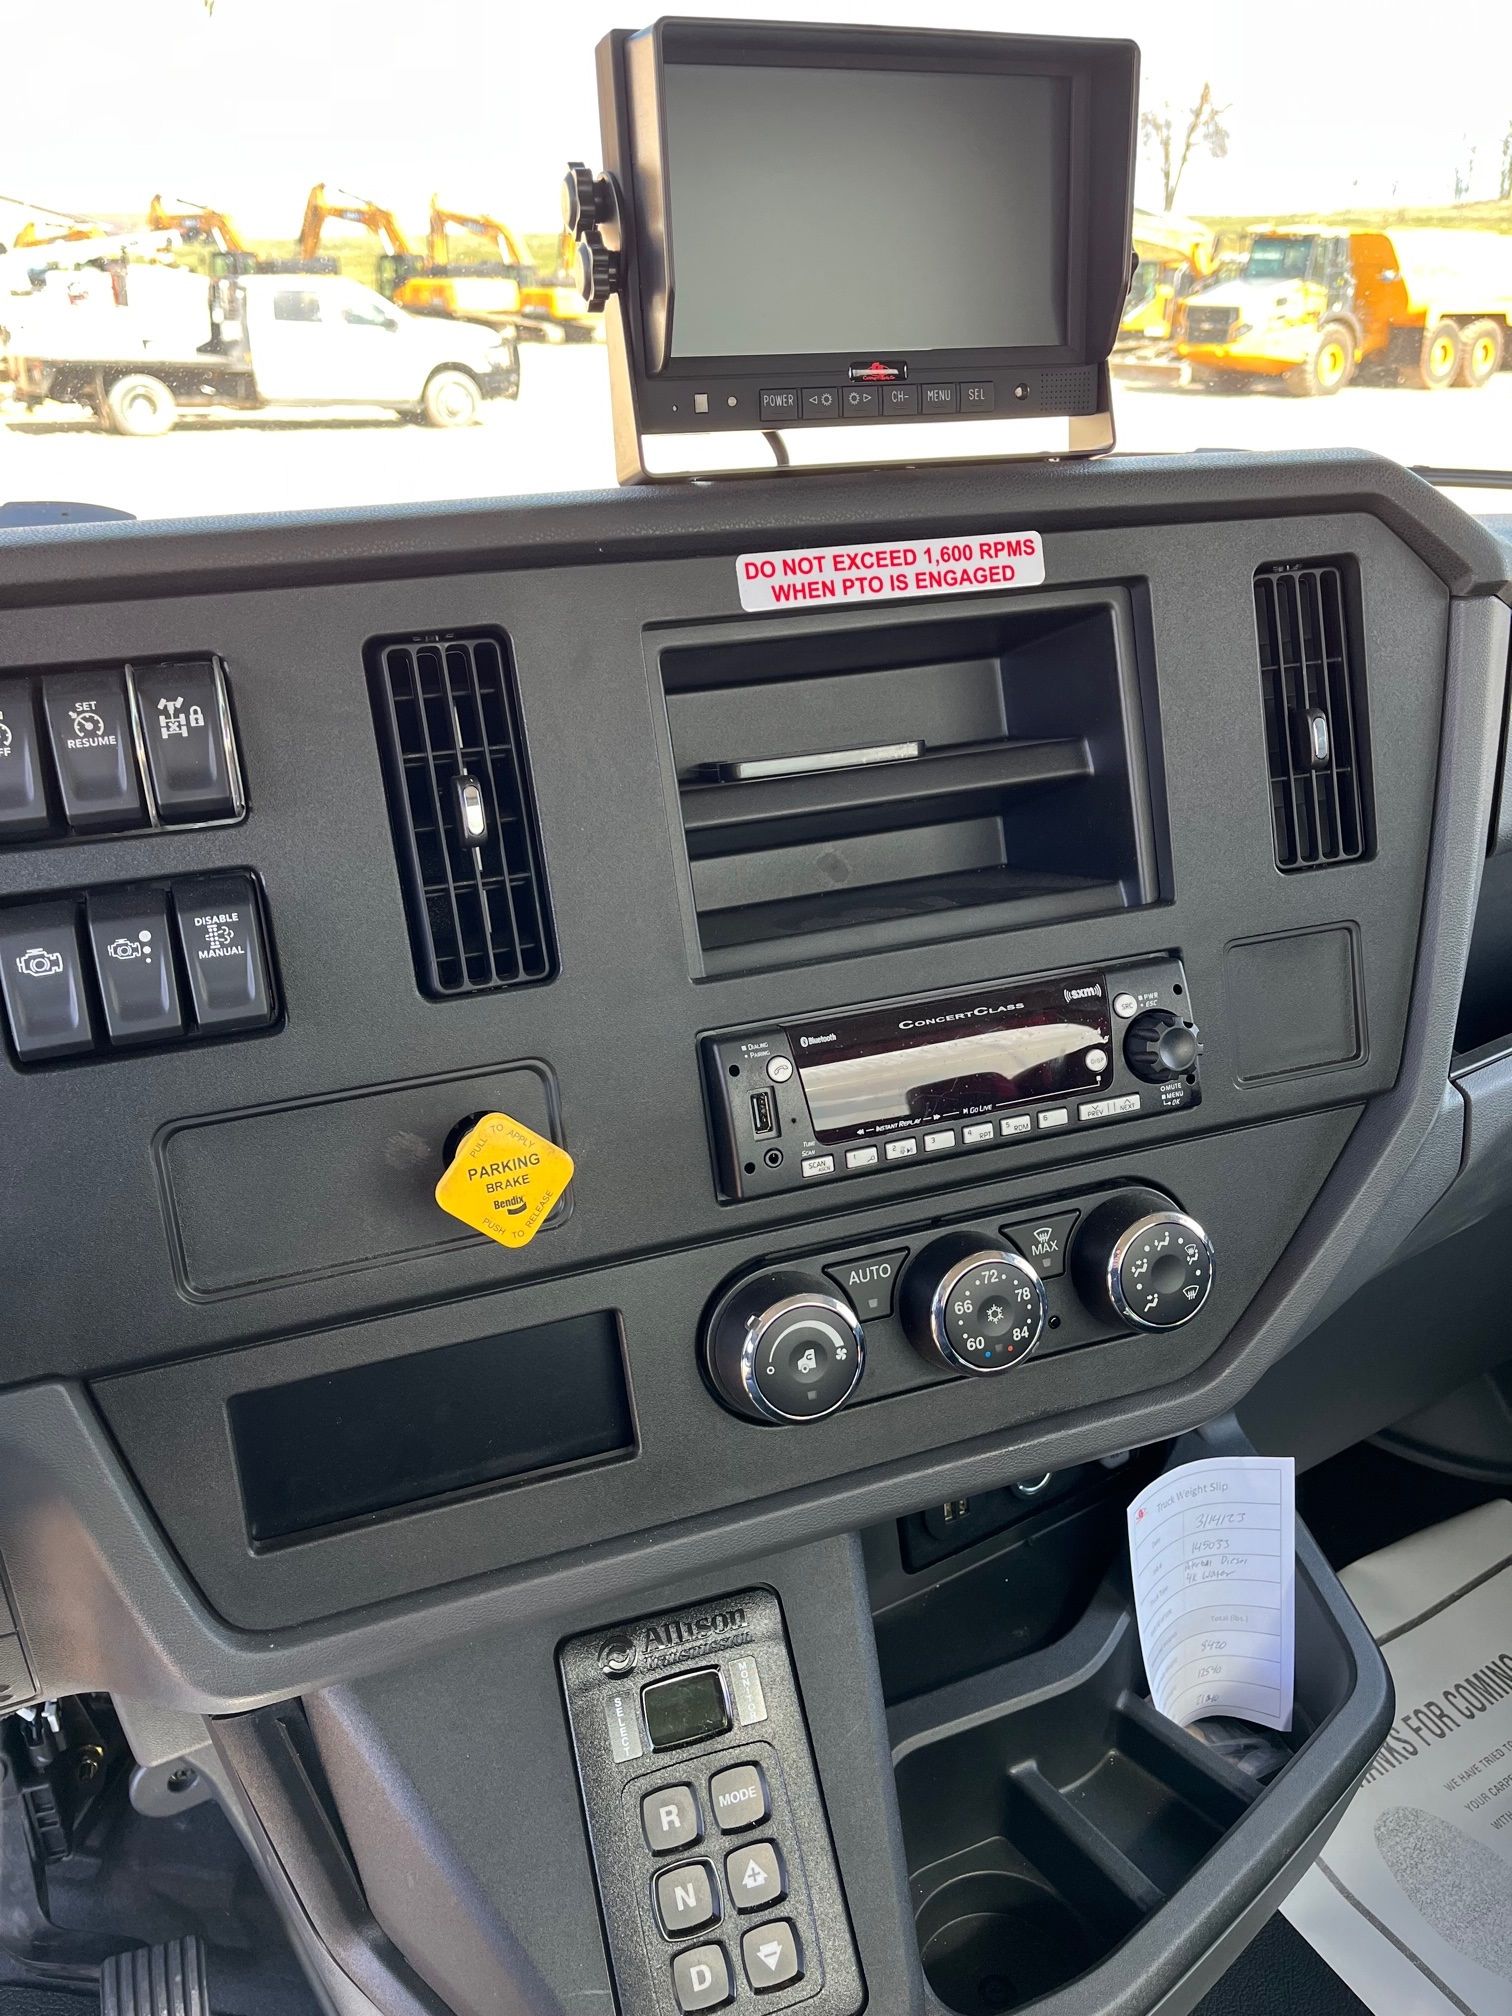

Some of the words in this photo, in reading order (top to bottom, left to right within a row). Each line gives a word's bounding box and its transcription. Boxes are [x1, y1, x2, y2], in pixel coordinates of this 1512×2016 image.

[763, 395, 794, 407] POWER
[891, 390, 910, 402] CH-
[927, 390, 951, 402] MENU
[968, 388, 985, 400] SEL
[744, 561, 776, 580] DO
[783, 556, 826, 576] NOT
[833, 549, 917, 571] EXCEED
[924, 544, 973, 567] 1,600
[979, 539, 1036, 560] RPMS
[771, 580, 837, 602] WHEN
[843, 577, 883, 596] PTO
[890, 574, 909, 591] IS
[915, 565, 1015, 589] ENGAGED
[75, 701, 97, 711] SET
[67, 735, 117, 749] RESUME
[0, 748, 11, 757] FF
[194, 913, 239, 926] DISABLE
[198, 945, 245, 959] MANUAL
[1143, 992, 1158, 1001] PWR
[808, 1033, 837, 1045] Bluetooth
[1166, 1083, 1182, 1091] MUTE
[1166, 1091, 1184, 1099] MENU
[1087, 1110, 1104, 1118] PREV
[1120, 1103, 1136, 1111] NEXT
[470, 1136, 488, 1158] PULL
[490, 1124, 504, 1134] TO
[507, 1129, 536, 1149] APPLY
[979, 1131, 992, 1139] RPT
[467, 1153, 540, 1181] PARKING
[808, 1160, 826, 1169] SCAN
[486, 1174, 530, 1193] BRAKE
[493, 1195, 525, 1210] Bendix
[482, 1217, 506, 1236] PUSH
[512, 1229, 525, 1239] TO
[525, 1189, 553, 1229] RELEASE
[1031, 1240, 1059, 1256] MAX
[849, 1263, 891, 1286] AUTO
[981, 1270, 999, 1284] 72
[1014, 1287, 1031, 1302] 78
[954, 1300, 973, 1315] 66
[1012, 1326, 1029, 1341] 84
[966, 1336, 985, 1351] 60
[1157, 1495, 1175, 1513] Truck
[1176, 1484, 1207, 1501] Weight
[1210, 1481, 1229, 1493] Slip
[644, 1608, 748, 1653] Allison
[738, 1662, 758, 1723] MONITOR
[614, 1697, 631, 1757] SELECT
[1401, 1701, 1461, 1746] FOR
[1443, 1778, 1461, 1792] WE
[1457, 1763, 1482, 1783] HAVE
[1479, 1748, 1505, 1768] TRIED
[718, 1785, 757, 1808] MODE
[1464, 1793, 1491, 1812] YOUR
[659, 1804, 681, 1832] R
[674, 1882, 697, 1911] N
[689, 1964, 712, 1992] D
